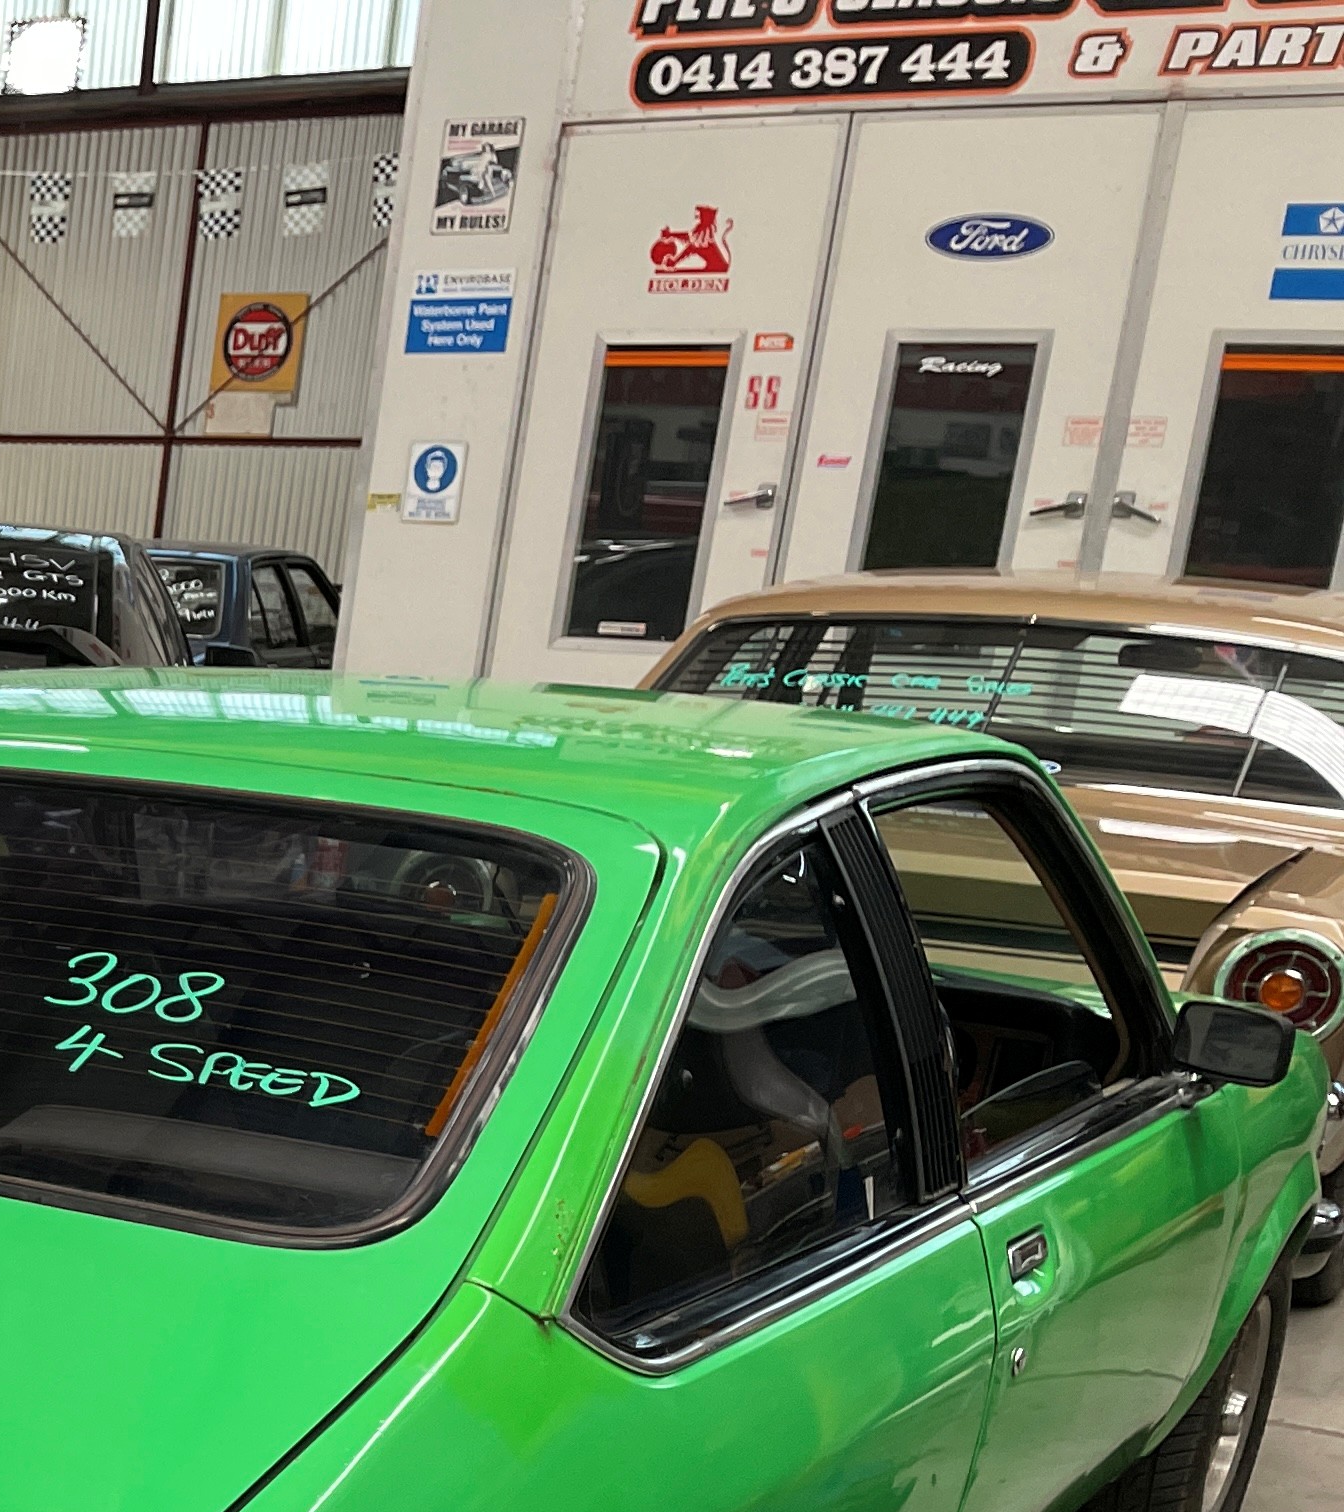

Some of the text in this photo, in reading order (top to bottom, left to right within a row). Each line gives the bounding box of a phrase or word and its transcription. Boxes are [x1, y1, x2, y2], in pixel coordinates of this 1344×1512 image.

[648, 40, 1011, 96] 0414 387 444
[1074, 35, 1124, 73] &
[950, 220, 1029, 252] Ford
[650, 279, 728, 293] HOLDEN
[233, 327, 286, 352] Duff
[919, 356, 1003, 377] Racing
[23, 570, 84, 588] GTS
[44, 952, 225, 1023] 308
[56, 1025, 361, 1108] 4 SPEED
